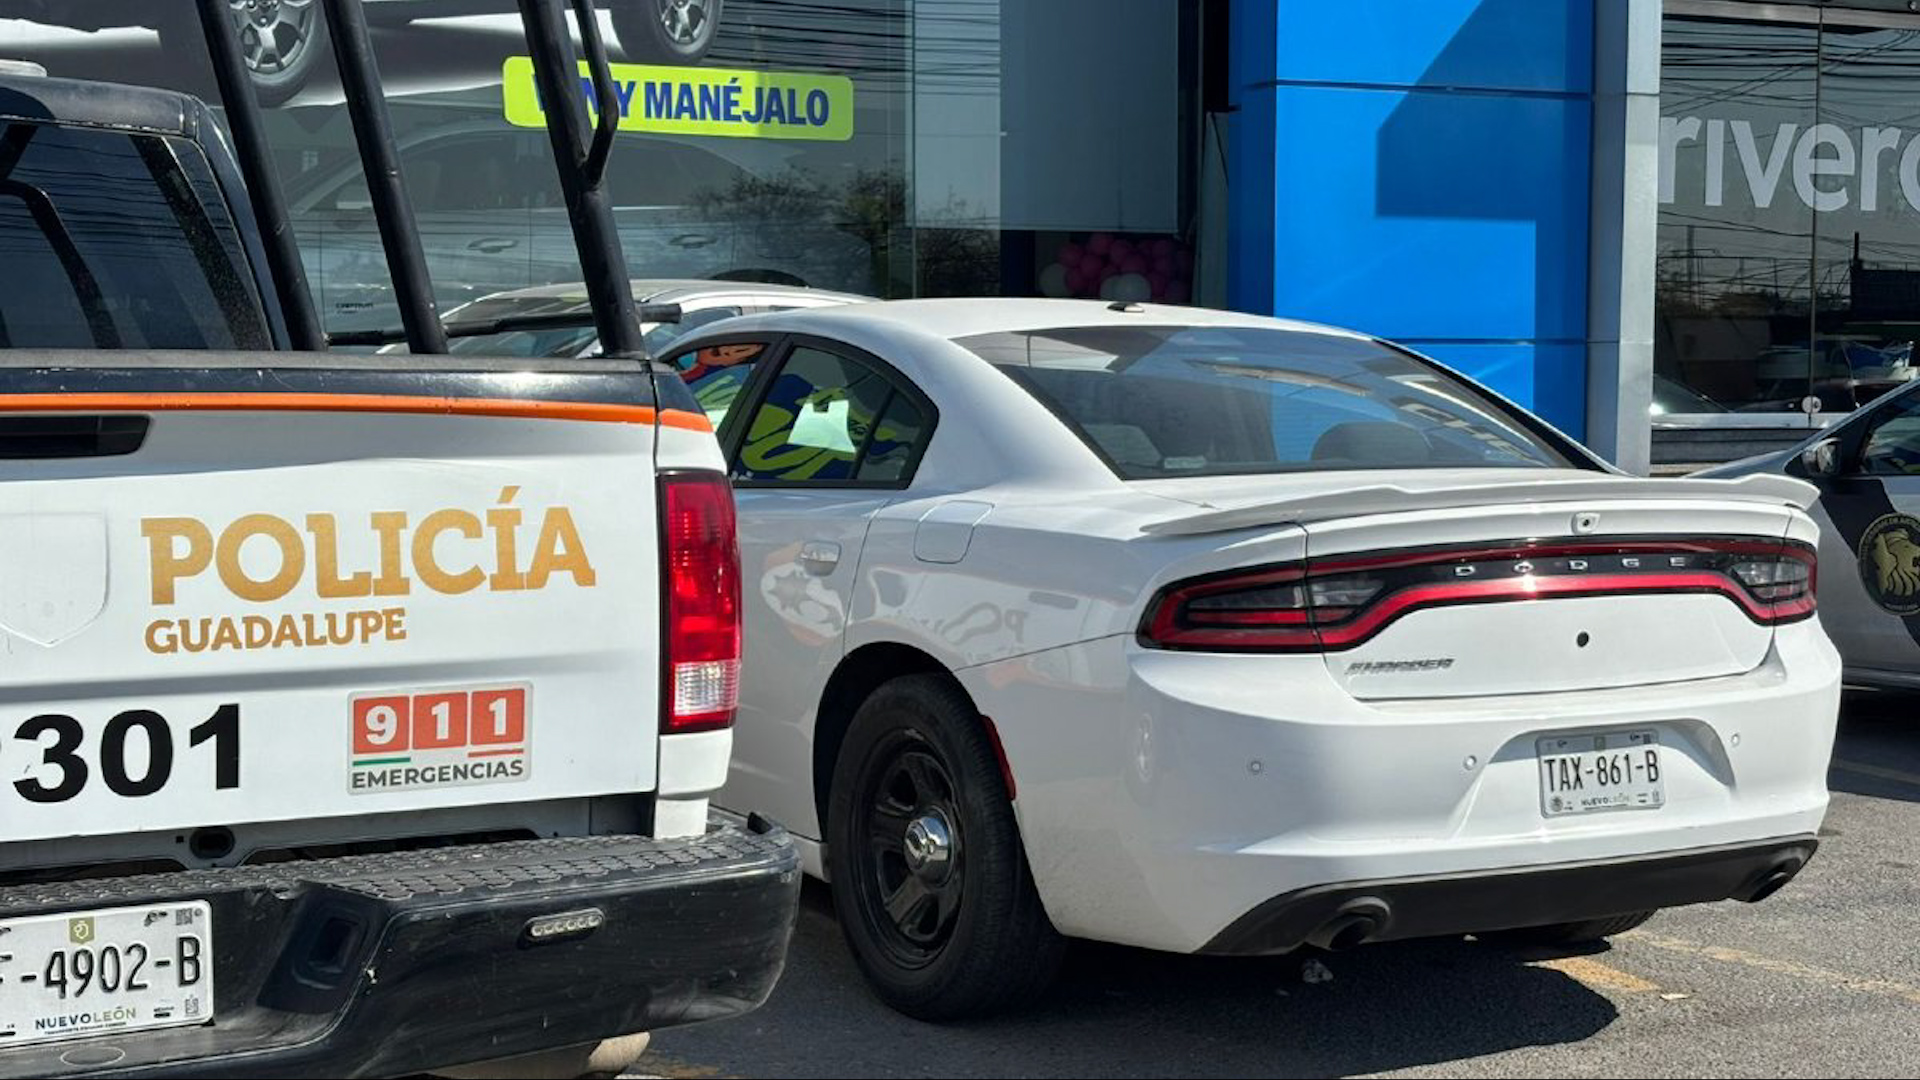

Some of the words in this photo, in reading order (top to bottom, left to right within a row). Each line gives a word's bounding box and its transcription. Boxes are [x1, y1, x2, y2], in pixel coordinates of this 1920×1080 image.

[612, 80, 637, 117] Y
[645, 77, 829, 126] MANÉJALO
[141, 486, 596, 605] POLICÍA
[1455, 556, 1686, 576] DODGE
[145, 608, 406, 654] GUADALUPE
[366, 698, 507, 745] 911
[0, 704, 241, 803] 301
[352, 760, 523, 789] EMERGENCIAS
[1544, 749, 1659, 792] TAX-861-B
[35, 1006, 136, 1030] NUEVOLEÓN
